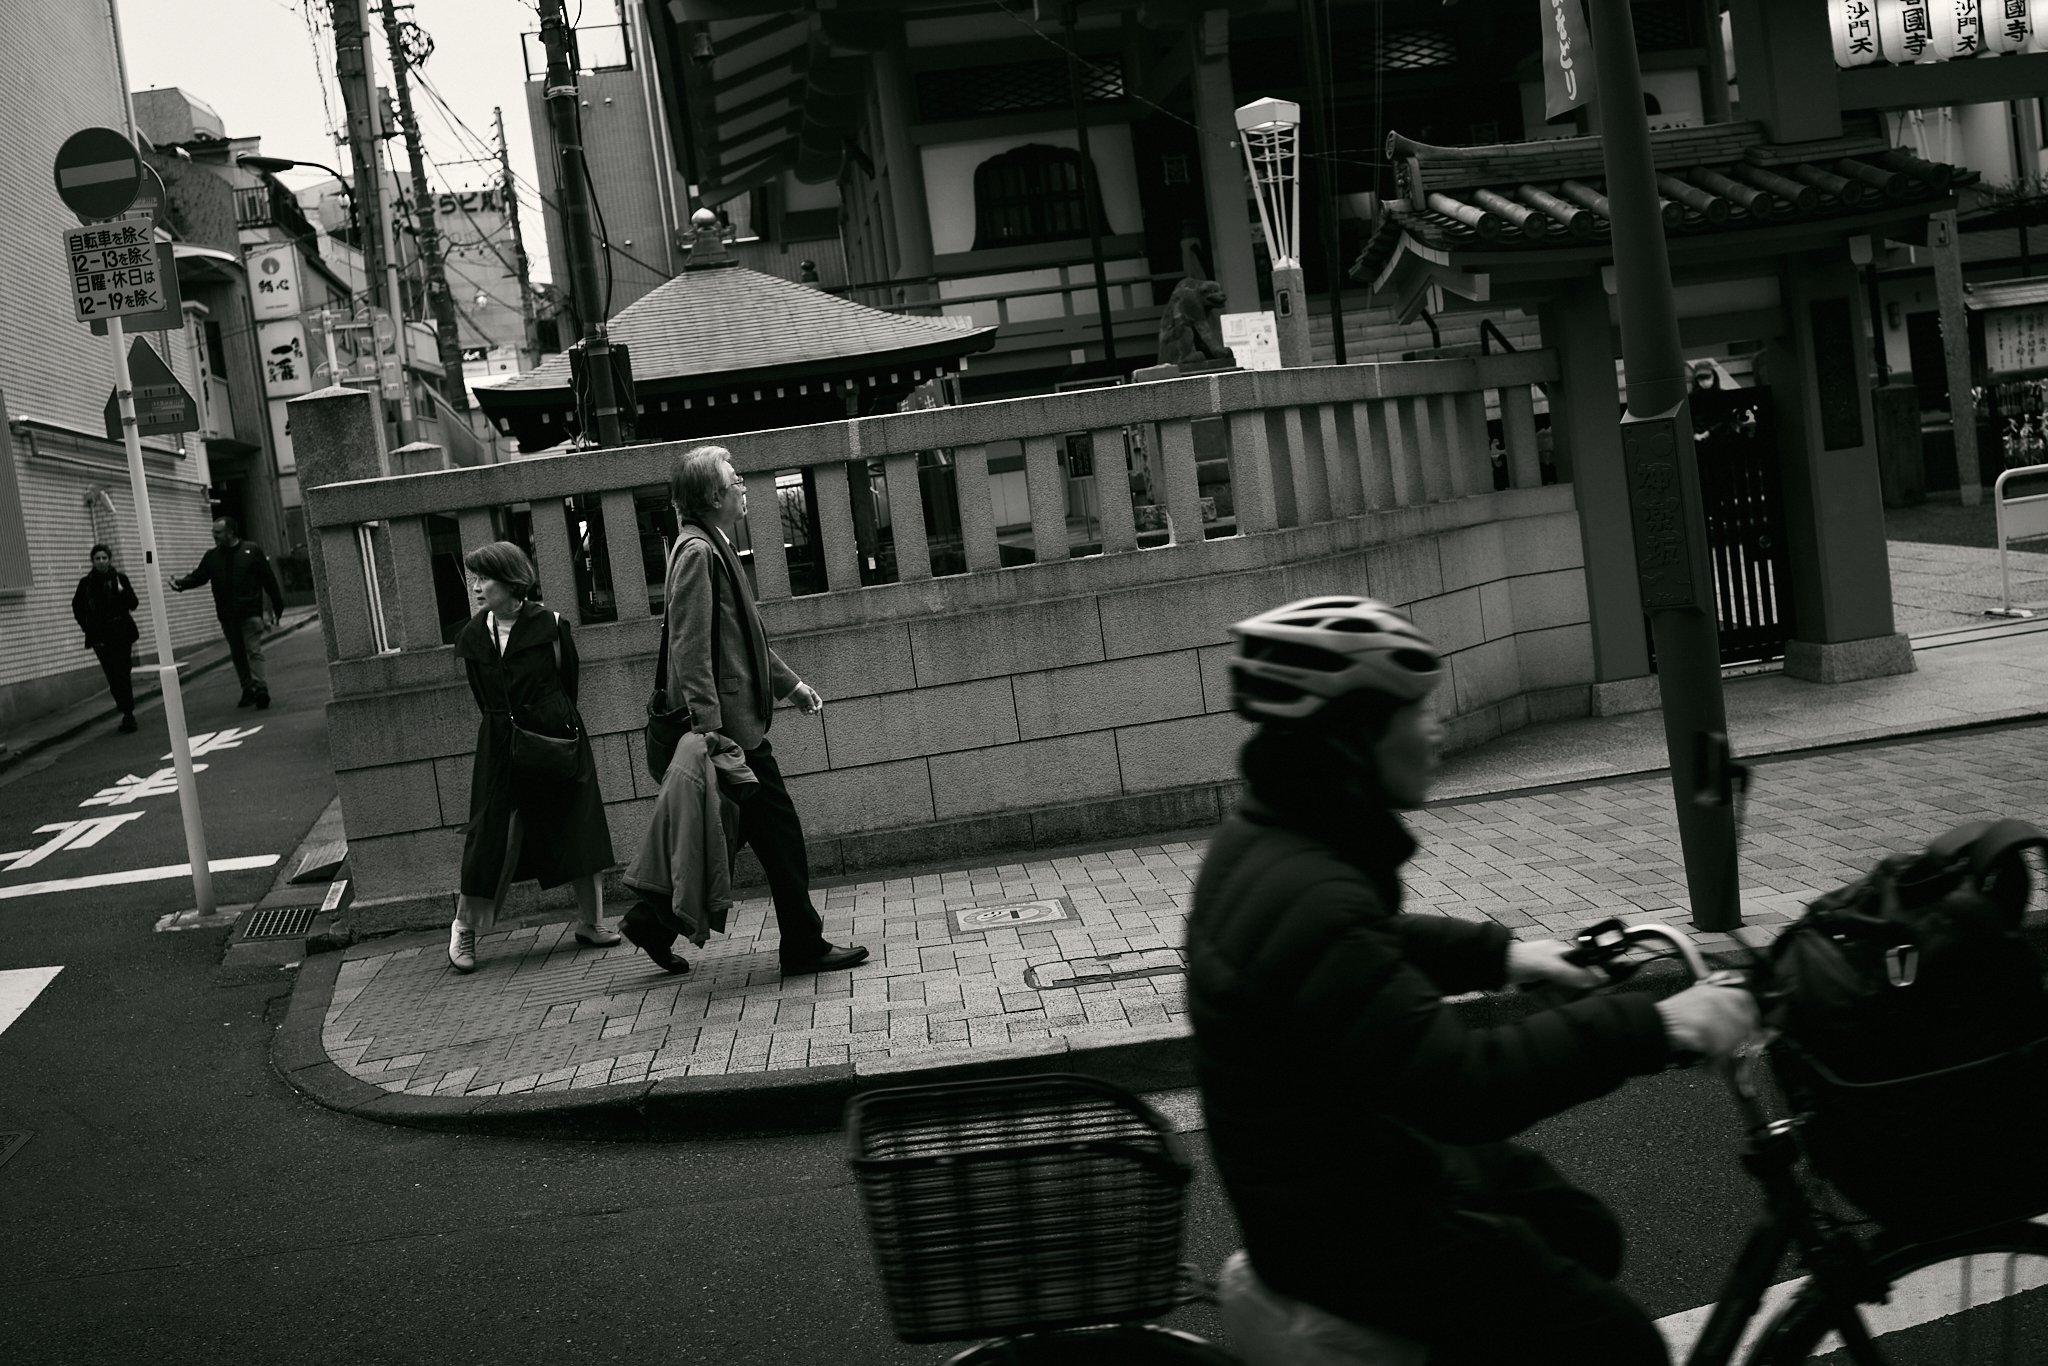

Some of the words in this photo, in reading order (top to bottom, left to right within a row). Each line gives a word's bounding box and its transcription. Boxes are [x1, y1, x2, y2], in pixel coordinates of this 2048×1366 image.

[1846, 0, 1873, 54] 沙門天
[1902, 0, 1927, 56] 國寺
[69, 226, 149, 252] 自転車を除く
[72, 247, 152, 273] 12-13を除く
[76, 268, 155, 293] 日曜・休日は
[79, 289, 158, 315] 12-19を除く
